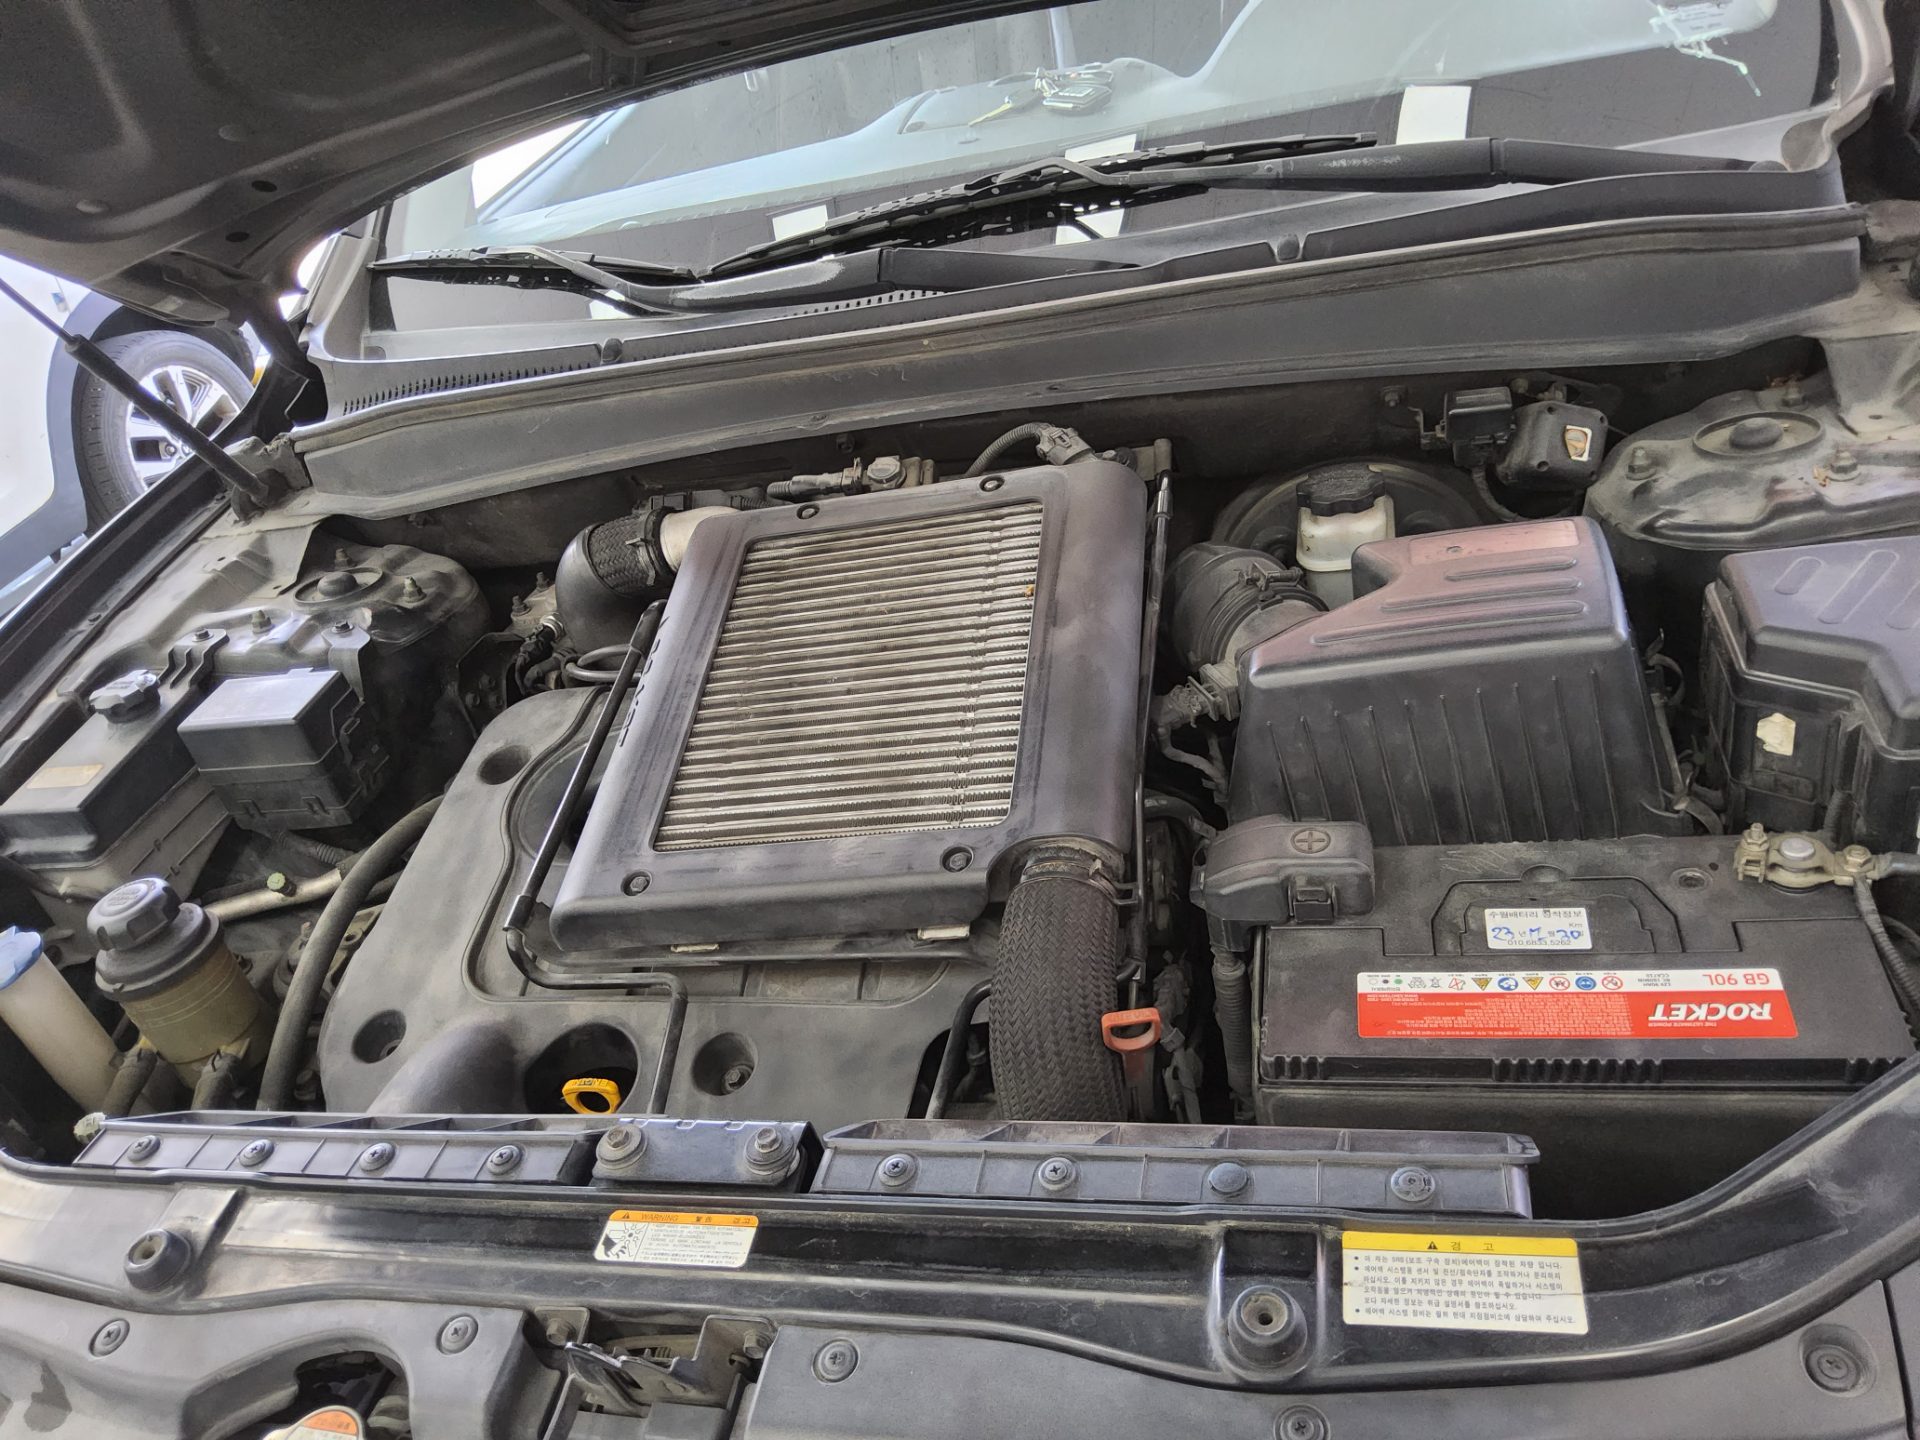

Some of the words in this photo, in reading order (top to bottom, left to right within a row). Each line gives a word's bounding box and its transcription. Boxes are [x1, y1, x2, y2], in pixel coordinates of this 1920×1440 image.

[1702, 973, 1738, 986] 90L
[1744, 972, 1770, 985] GB
[1648, 1002, 1773, 1021] ROCKET
[640, 1214, 680, 1222] WARNING
